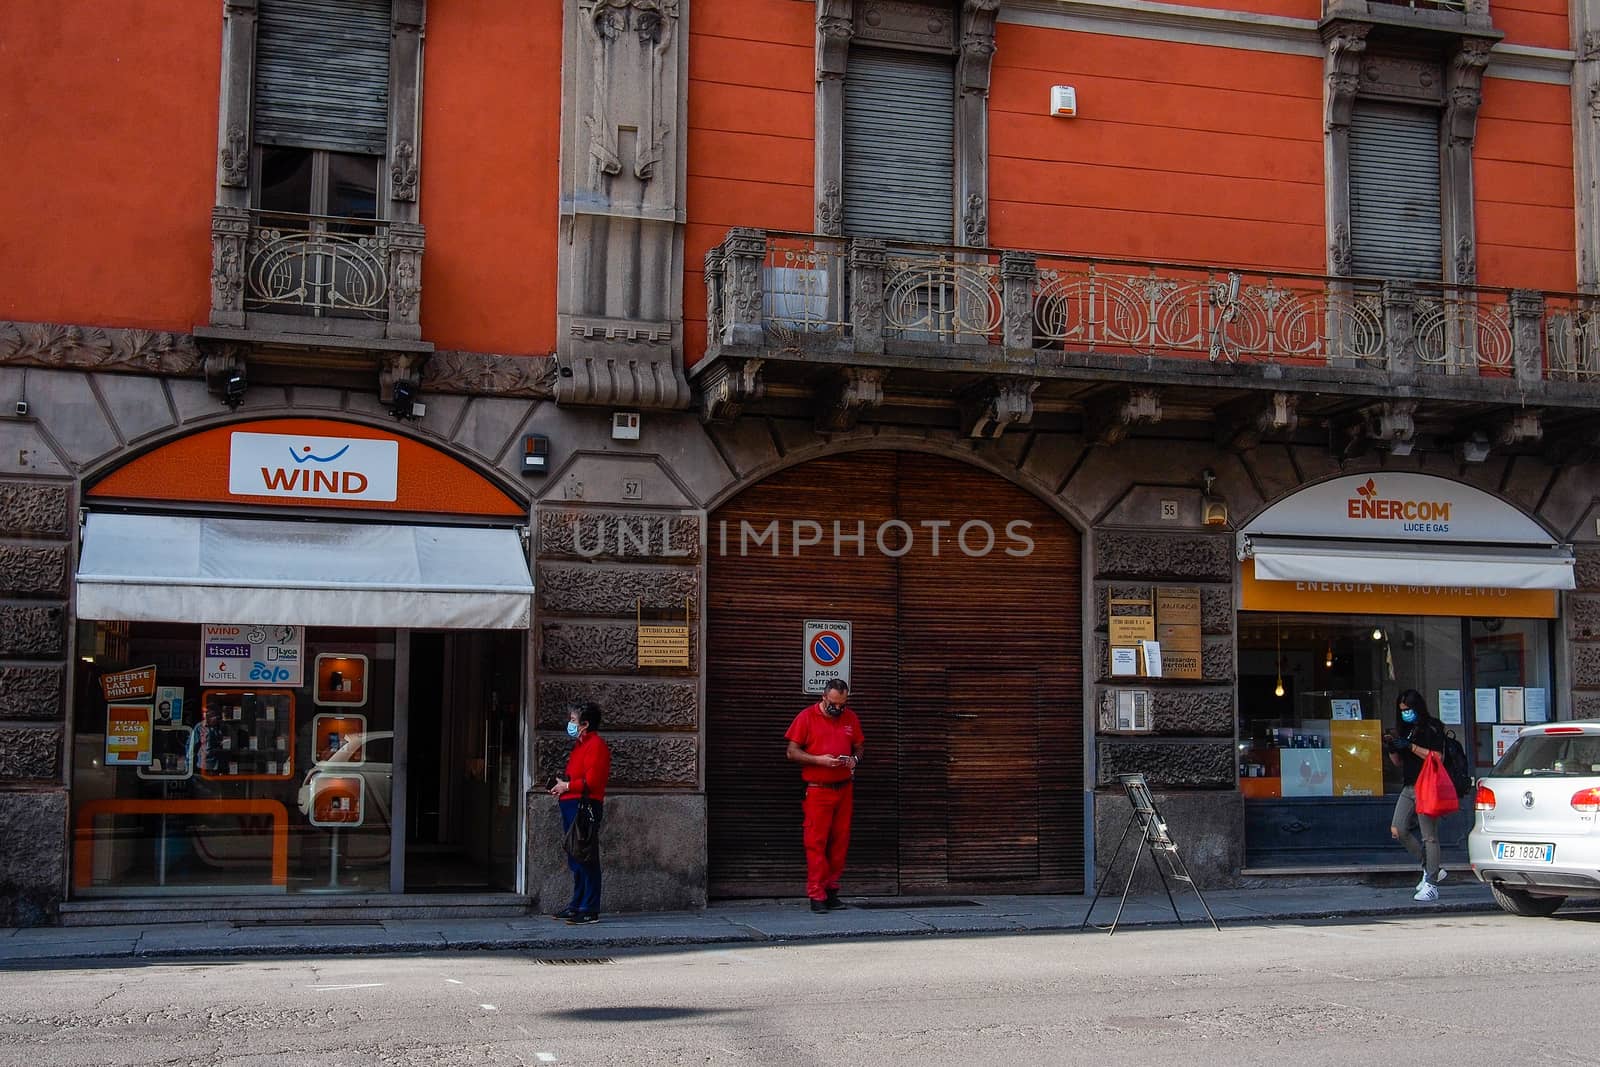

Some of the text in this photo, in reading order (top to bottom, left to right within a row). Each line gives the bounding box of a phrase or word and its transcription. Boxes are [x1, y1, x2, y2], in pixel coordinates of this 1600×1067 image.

[261, 467, 368, 494] WIND
[626, 482, 638, 495] 57
[1164, 504, 1175, 516] 55
[1348, 498, 1449, 521] ENERCOM
[1403, 523, 1449, 533] LUCE E GAS
[1296, 581, 1373, 593] ENERGIA
[1382, 583, 1399, 593] IN
[207, 626, 240, 635] WIND
[209, 646, 249, 656] tiscali:
[105, 671, 150, 684] OFFERTE
[208, 672, 237, 680] NOITEL
[815, 670, 839, 678] passo
[106, 680, 131, 690] LAST
[107, 685, 145, 697] MINUTE
[1504, 845, 1546, 859] EB 188ZN
